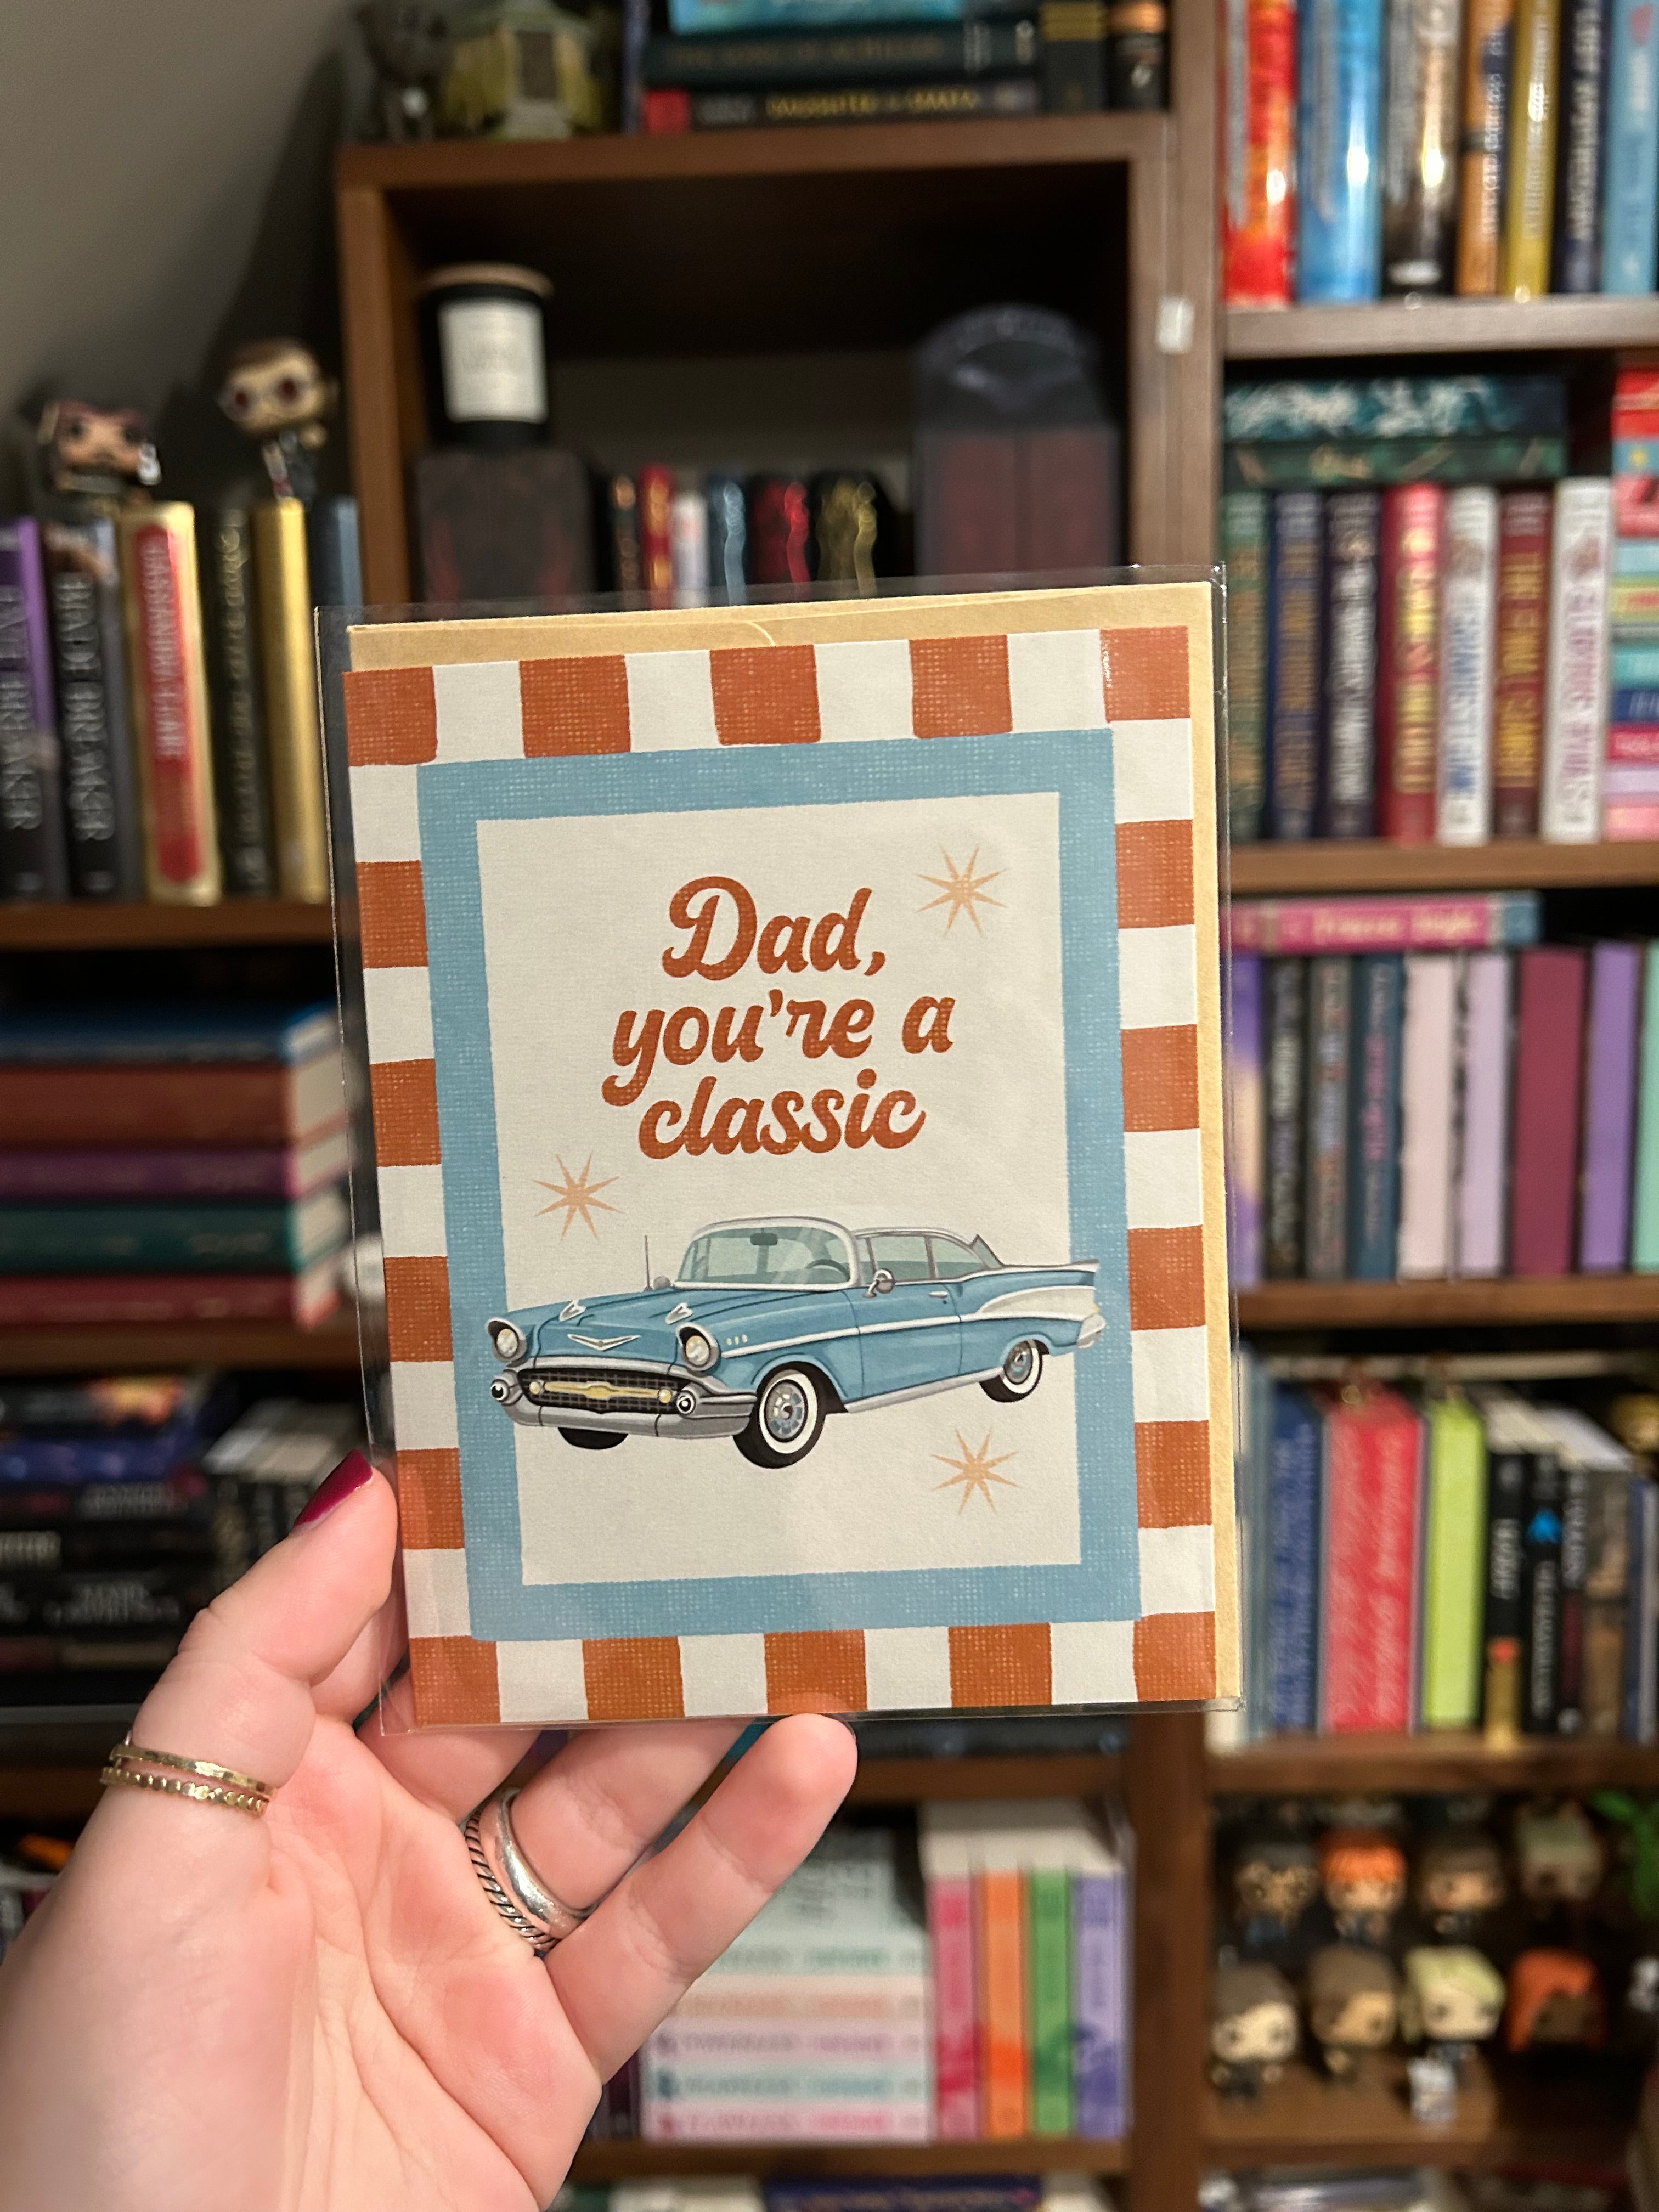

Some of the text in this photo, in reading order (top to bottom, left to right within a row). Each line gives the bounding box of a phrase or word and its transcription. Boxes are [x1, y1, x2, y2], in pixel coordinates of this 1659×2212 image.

[662, 876, 885, 980] Dad,
[901, 996, 956, 1054] a
[638, 1068, 926, 1159] classic
